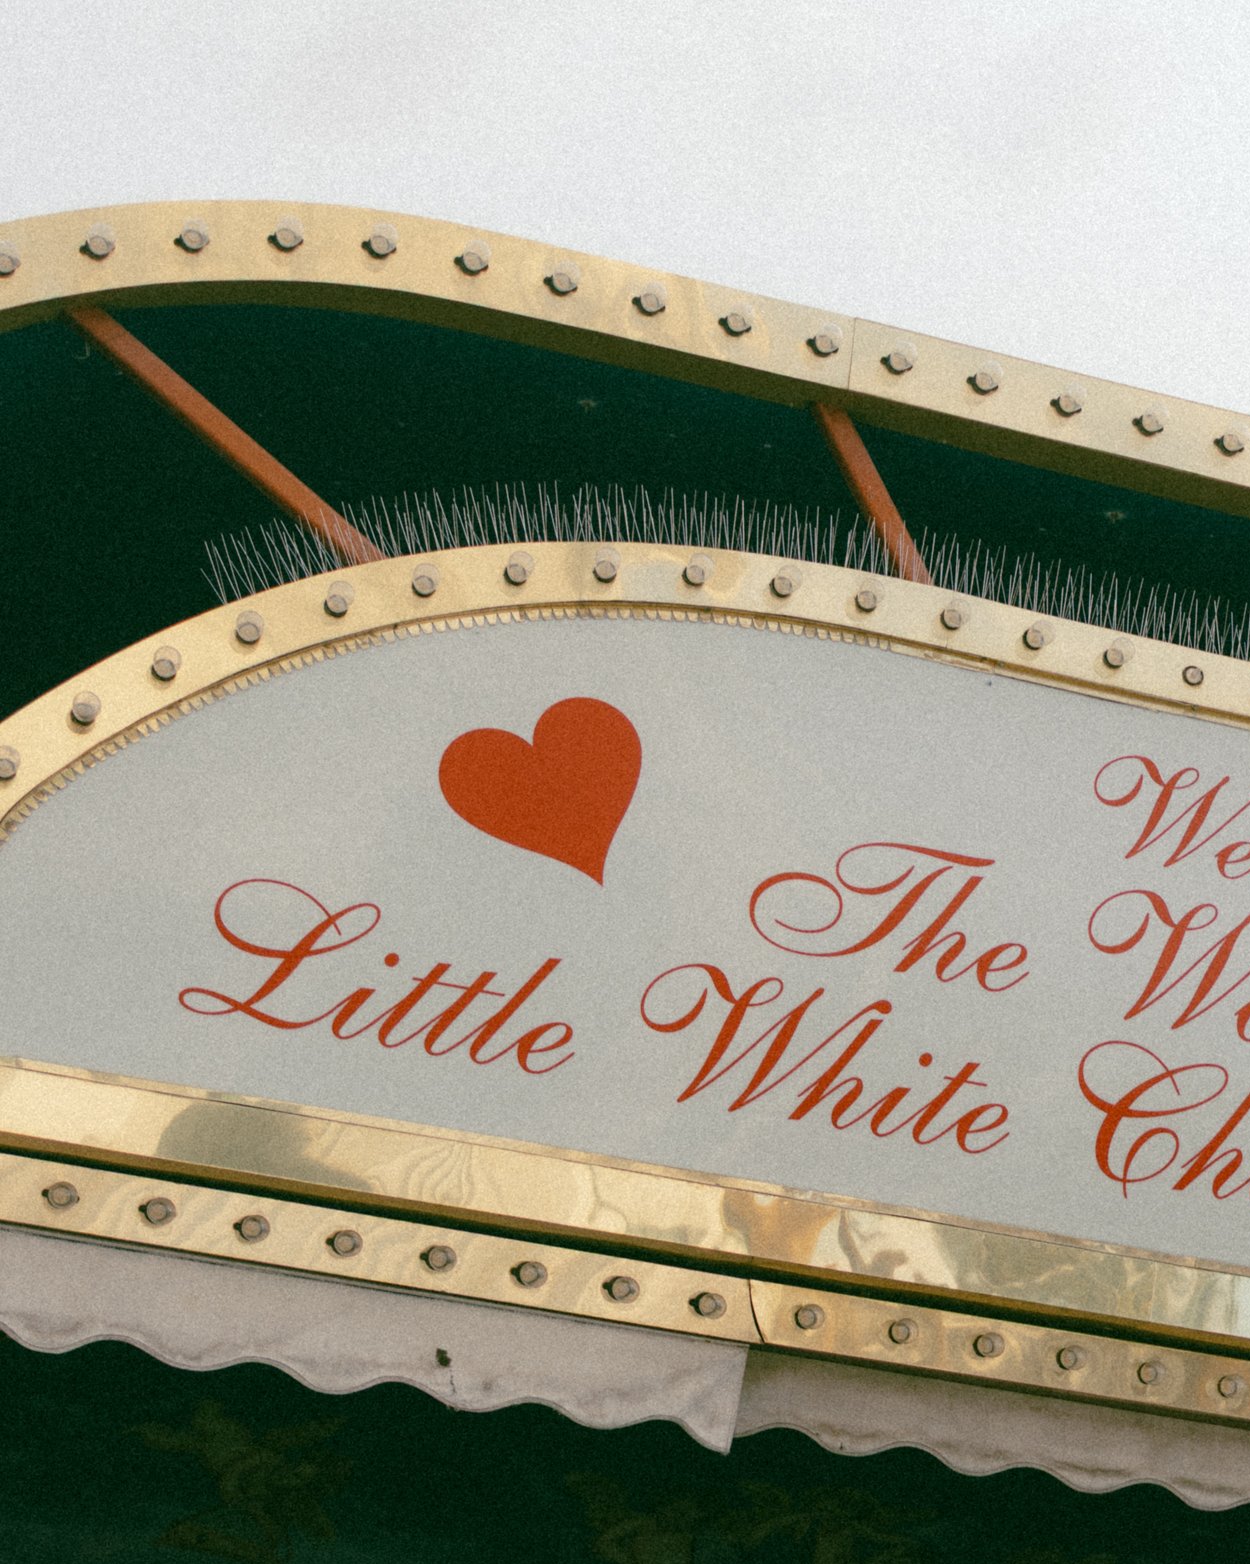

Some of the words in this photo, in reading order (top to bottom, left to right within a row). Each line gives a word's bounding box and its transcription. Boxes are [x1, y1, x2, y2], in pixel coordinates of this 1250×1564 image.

[178, 878, 576, 1075] Little
[640, 963, 1010, 1155] White
[749, 842, 1030, 993] The
